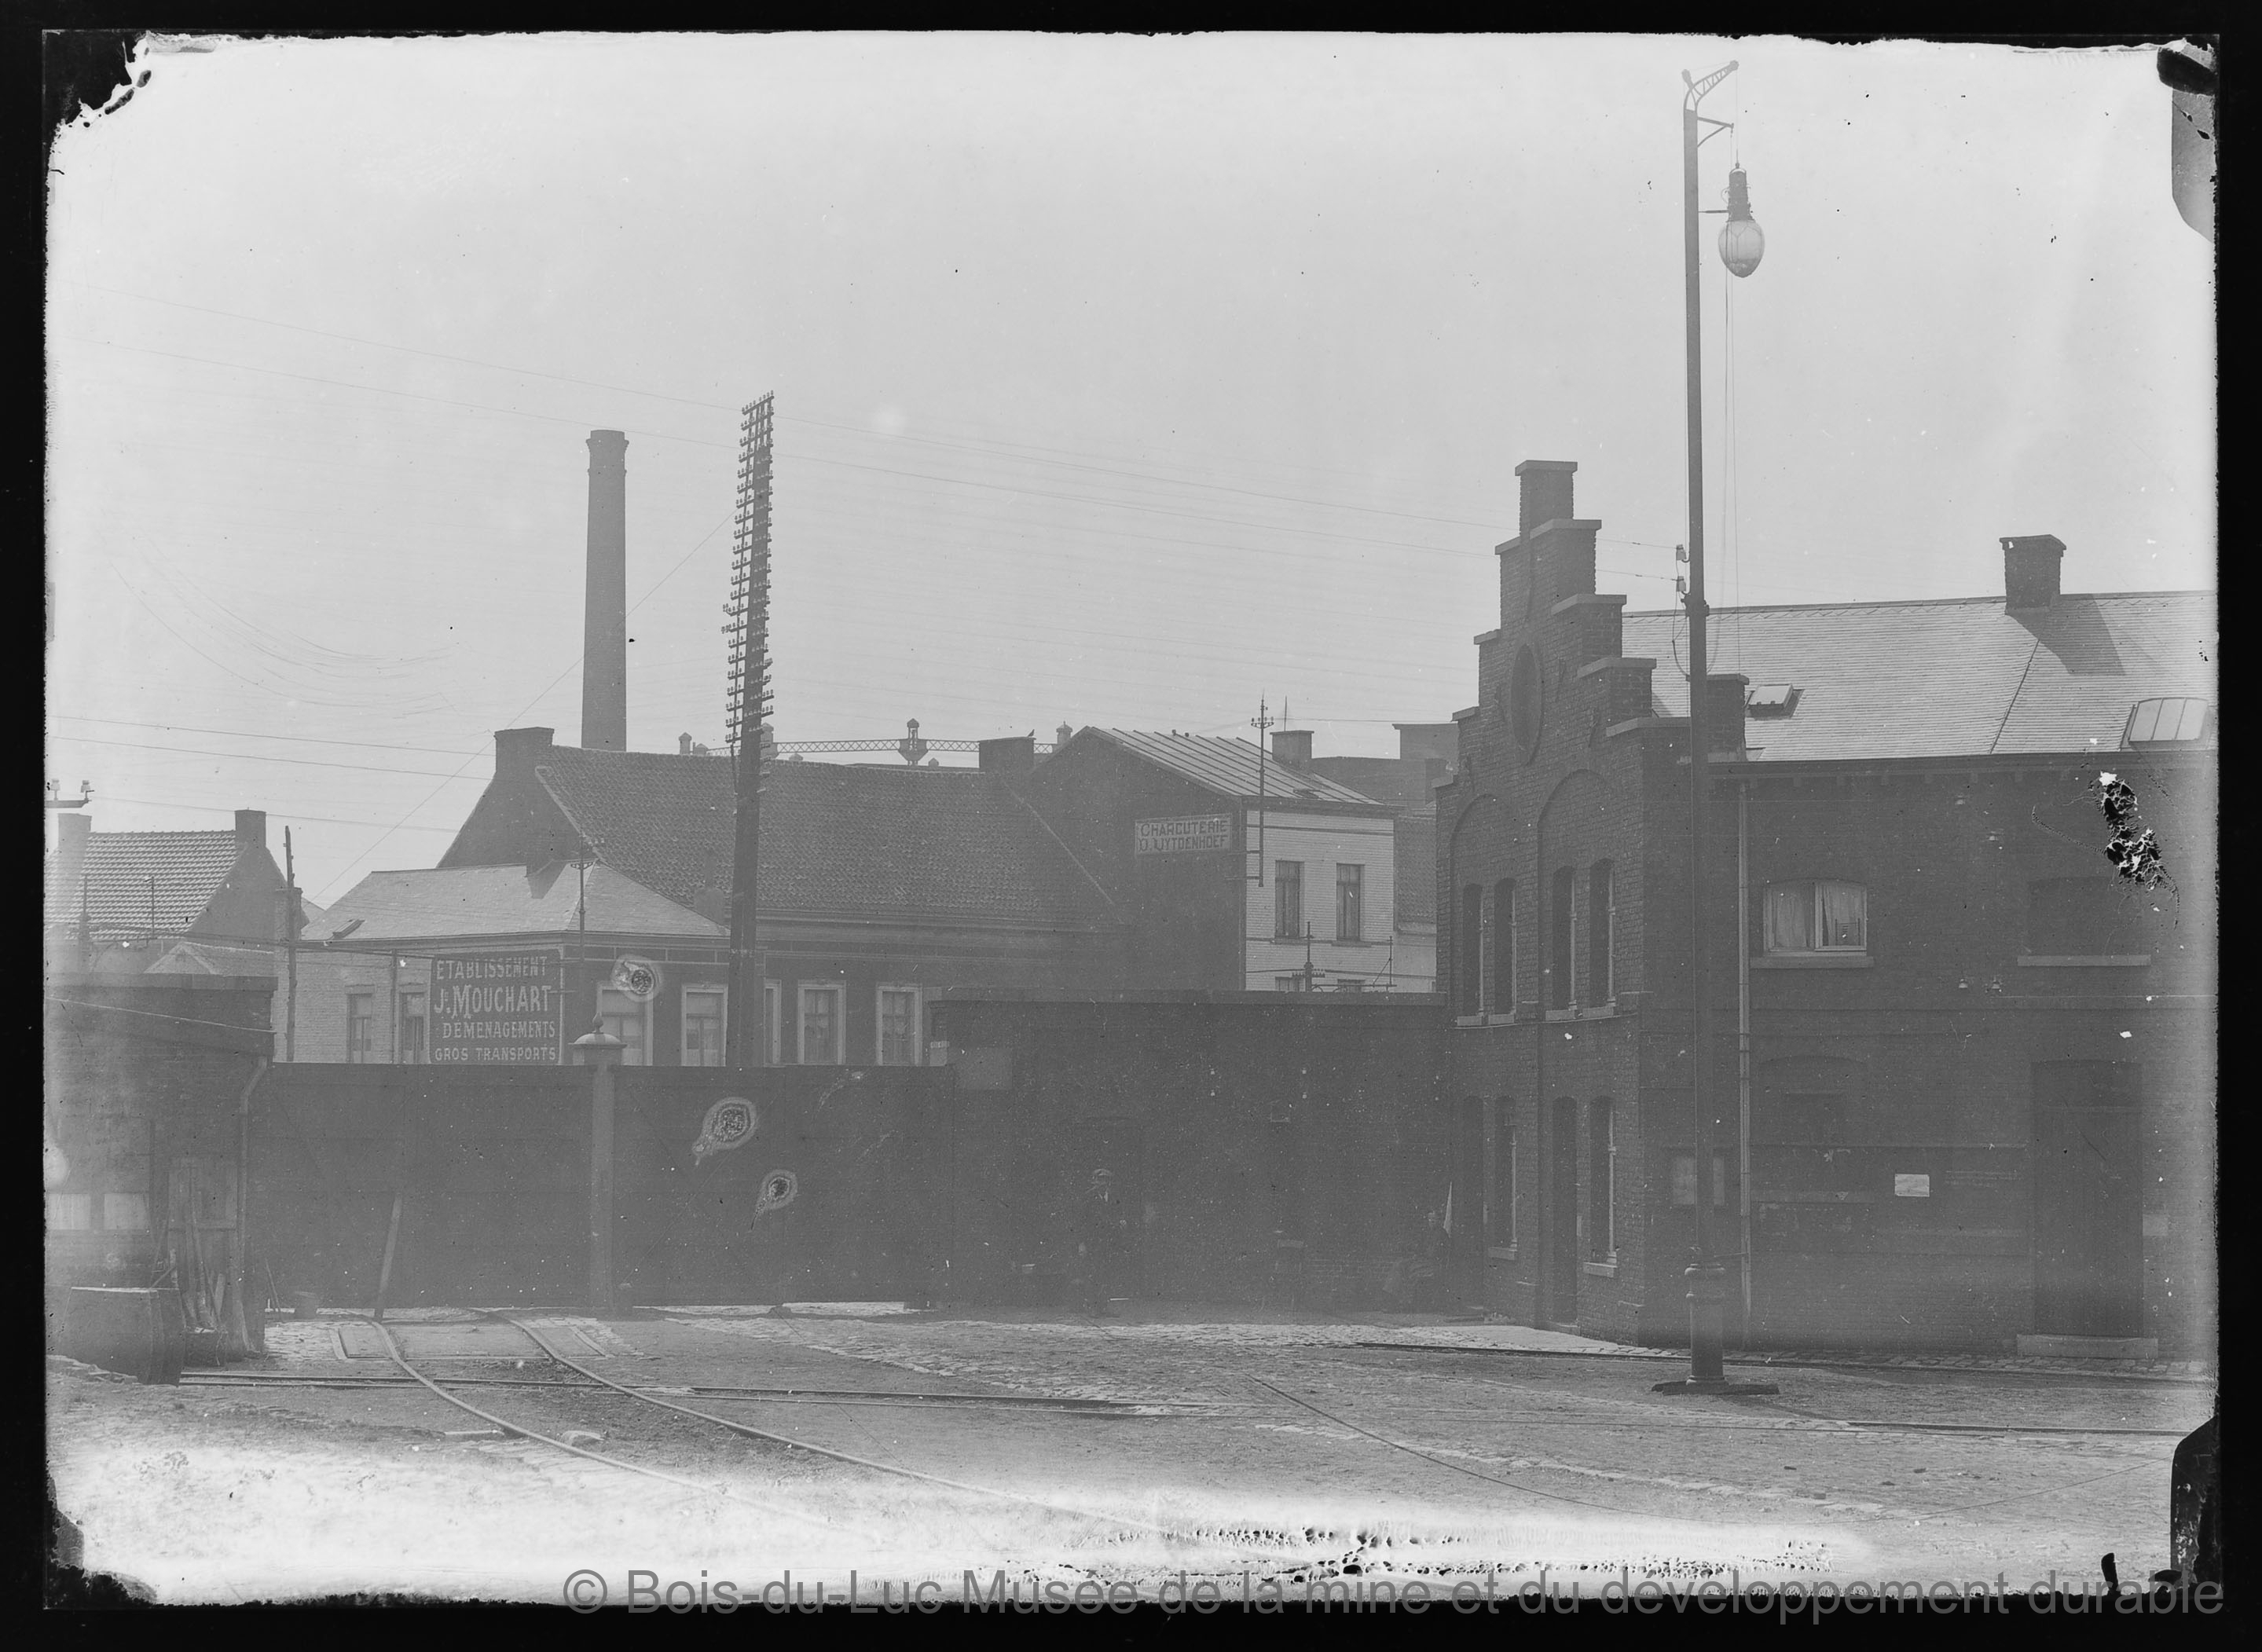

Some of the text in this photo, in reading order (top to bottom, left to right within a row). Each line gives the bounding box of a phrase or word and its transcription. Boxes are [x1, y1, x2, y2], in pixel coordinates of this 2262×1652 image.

[1140, 820, 1227, 837] CHARCUTERIE
[436, 956, 548, 980] ETABLISSEMENT
[451, 984, 552, 1020] MOUCHART
[442, 1020, 555, 1039] DEMENAGEMENTS
[434, 1046, 556, 1061] GROS TRANSPORTS
